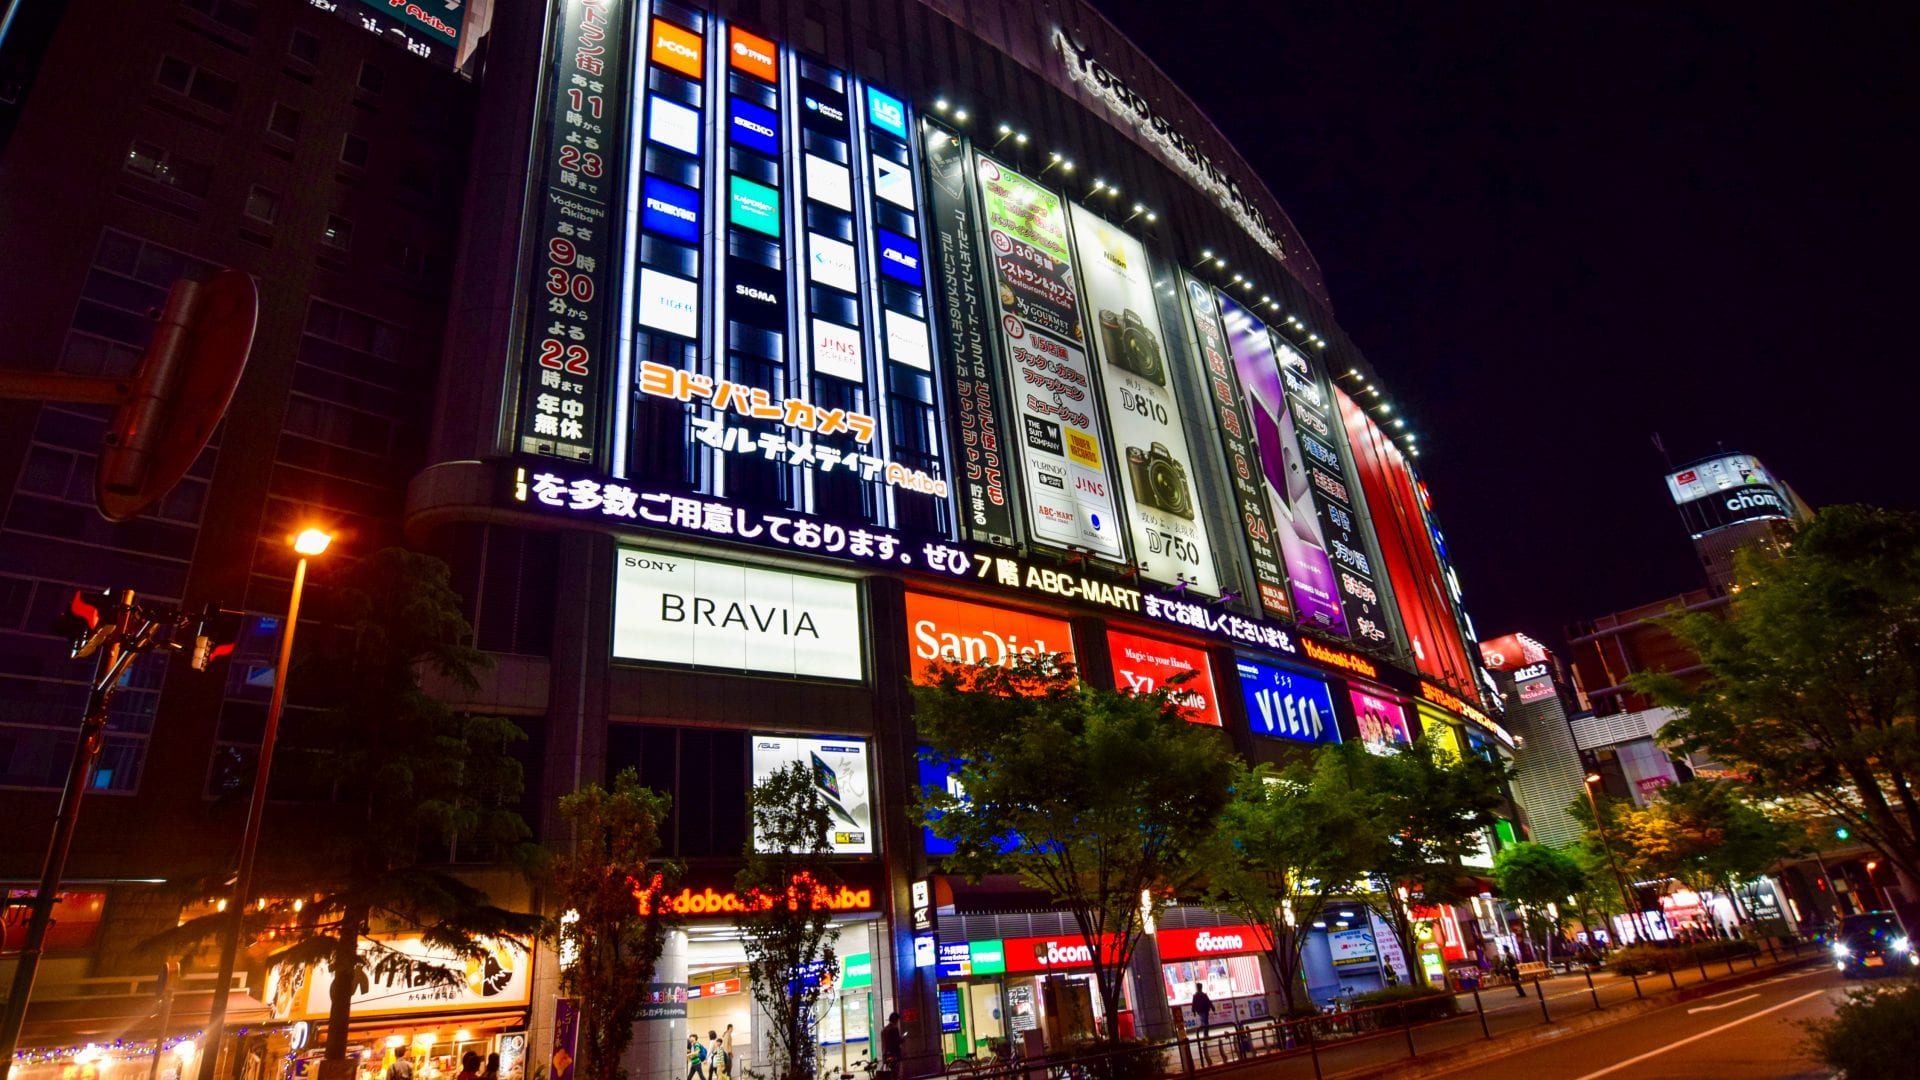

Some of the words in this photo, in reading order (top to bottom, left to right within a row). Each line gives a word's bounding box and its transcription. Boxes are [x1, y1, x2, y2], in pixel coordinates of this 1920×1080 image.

[406, 4, 456, 38] Akiba
[571, 74, 604, 93] あさ
[568, 89, 602, 118] 11
[566, 110, 602, 134] 時から
[734, 116, 774, 137] SEIKO
[566, 131, 600, 150] よる
[559, 145, 603, 177] 23
[560, 170, 598, 194] 時まで
[550, 193, 605, 218] Yodobashi
[560, 206, 594, 223] Akiba
[557, 221, 593, 240] あさ
[883, 248, 918, 270] ASUS
[1103, 249, 1128, 270] Nikon
[546, 267, 594, 302] 30
[735, 284, 777, 304] SIGMA
[548, 297, 589, 321] 分から
[1030, 307, 1069, 330] GOURMET
[548, 321, 586, 341] よる
[539, 339, 589, 376] 22
[541, 370, 584, 395] 時まで
[1022, 367, 1085, 402] ファッション
[536, 393, 584, 419] 年中
[639, 361, 876, 444] ヨドバシカメラ
[1120, 387, 1168, 426] D810
[534, 414, 583, 440] 無休
[1027, 418, 1041, 431] THE
[1028, 427, 1043, 439] SUIT
[1029, 435, 1060, 451] COMPANY
[690, 417, 886, 481] マルチメディア
[885, 463, 949, 499] Akiba
[1031, 459, 1067, 477] YURINDO
[1038, 505, 1074, 522] ABC-MART
[1245, 512, 1270, 544] 24
[1146, 528, 1200, 566] D750
[624, 557, 677, 573] SONY
[661, 592, 820, 640] BRAVIA
[1026, 565, 1141, 613] ABC-MART
[1143, 593, 1297, 654] までお越しくださいませ。
[1125, 647, 1146, 663] Magic
[1147, 652, 1155, 663] in
[1154, 655, 1170, 667] your
[1254, 687, 1324, 740] VIERA
[757, 742, 780, 750] ASUS
[1037, 942, 1096, 965] ocom
[1195, 932, 1243, 953] docomo
